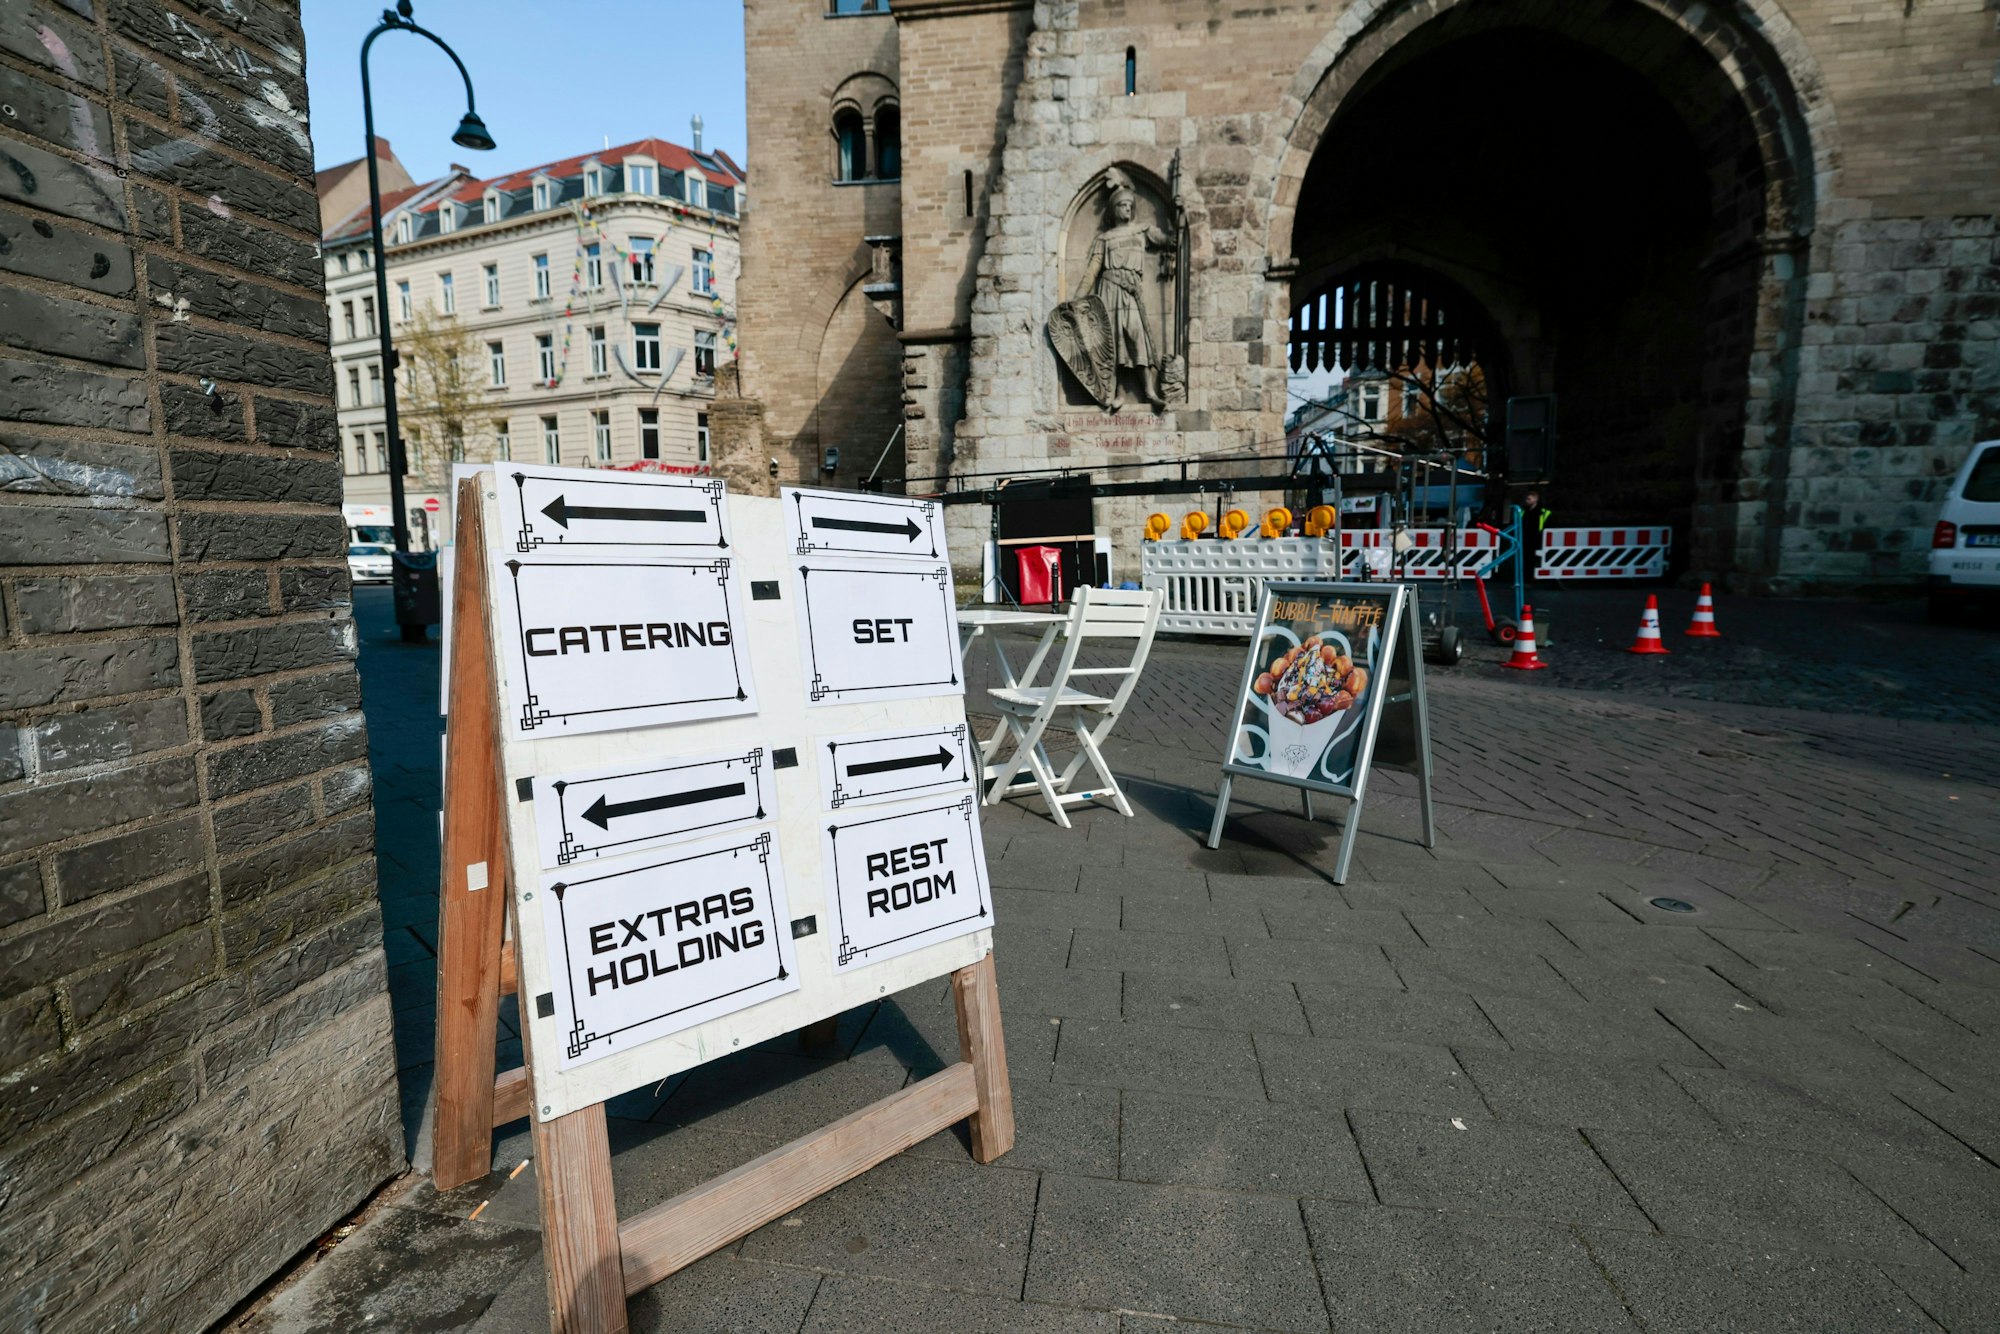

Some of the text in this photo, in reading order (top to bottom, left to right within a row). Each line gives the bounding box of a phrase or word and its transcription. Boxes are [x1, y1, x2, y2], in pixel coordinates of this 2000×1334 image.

[526, 622, 731, 657] CATERING
[853, 619, 913, 644] SET
[866, 838, 949, 882] REST
[866, 871, 957, 918] ROOM
[589, 886, 755, 957] EXTRAS
[586, 919, 765, 997] HOLDING
